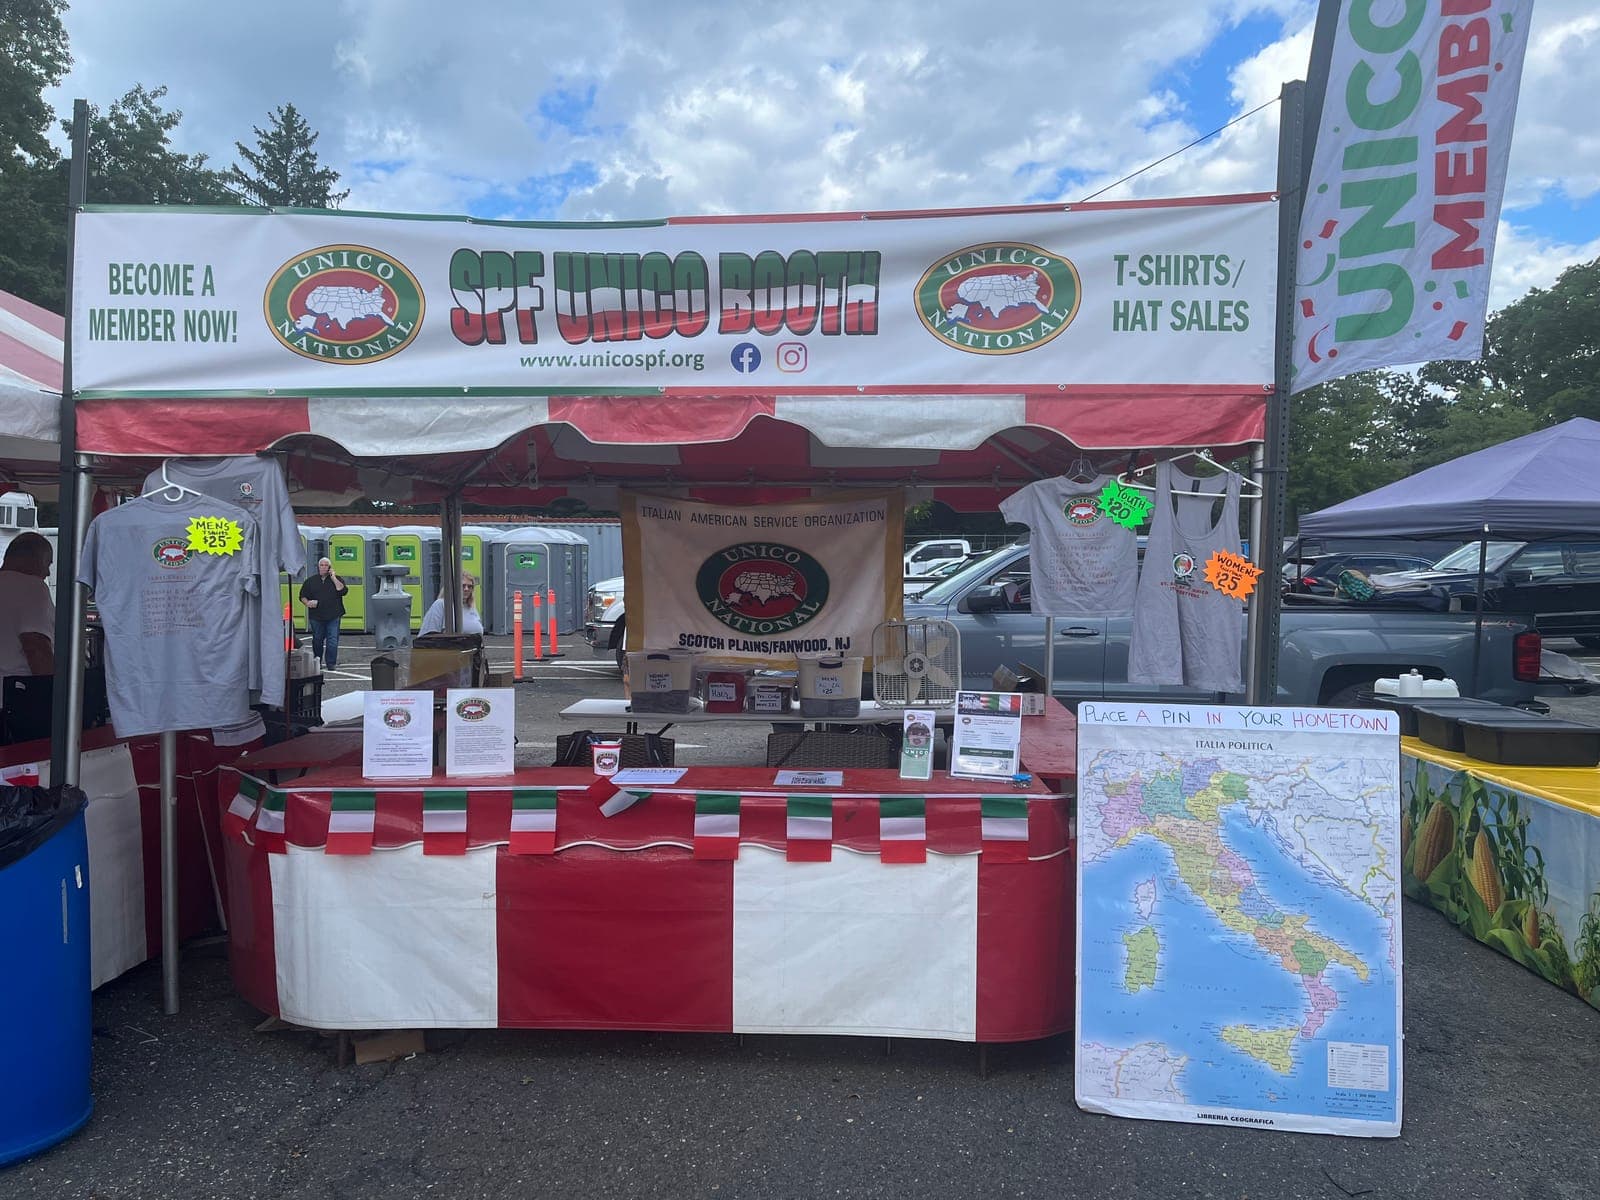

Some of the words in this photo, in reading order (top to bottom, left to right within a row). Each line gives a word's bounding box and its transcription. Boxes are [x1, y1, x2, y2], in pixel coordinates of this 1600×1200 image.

[292, 252, 394, 281] UNICO
[943, 247, 1053, 275] UNICO
[1113, 253, 1246, 288] T-SHIRTS/
[108, 263, 195, 297] BECOME
[201, 264, 215, 296] A
[449, 248, 546, 346] SPF
[553, 250, 708, 344] UNICO
[718, 250, 881, 337] BOOTH
[89, 308, 175, 342] MEMBER
[184, 309, 238, 343] NOW!
[926, 305, 1070, 349] NATIONAL
[1112, 300, 1161, 332] HAT
[1170, 300, 1250, 332] SALES
[277, 319, 414, 359] NATIONAL
[520, 350, 705, 373] www.unicospf.org
[1107, 497, 1131, 519] $20
[1117, 485, 1146, 509] YOUTH
[196, 521, 230, 530] MENS
[641, 505, 681, 522] ITALIAN
[690, 512, 747, 527] AMERICAN
[753, 515, 799, 528] SERVICE
[804, 509, 885, 527] ORGANIZATION
[722, 545, 802, 565] UNICO
[1217, 554, 1256, 578] WOMENS
[1216, 571, 1241, 591] $25
[706, 597, 821, 634] NATIONAL
[679, 633, 725, 648] SCOTCH
[835, 637, 851, 651] NJ
[1084, 705, 1128, 723] PLACE
[1136, 710, 1150, 723] A
[1162, 711, 1191, 723] PIN
[1207, 712, 1222, 725] IN
[1239, 711, 1284, 727] YOUR
[1293, 712, 1389, 731] HOMETOWN
[1195, 740, 1226, 749] ITALIA
[1228, 741, 1273, 751] POLITICA
[1197, 1113, 1229, 1121] LIBRERIA
[1231, 1115, 1274, 1125] GEOGRAFICA
